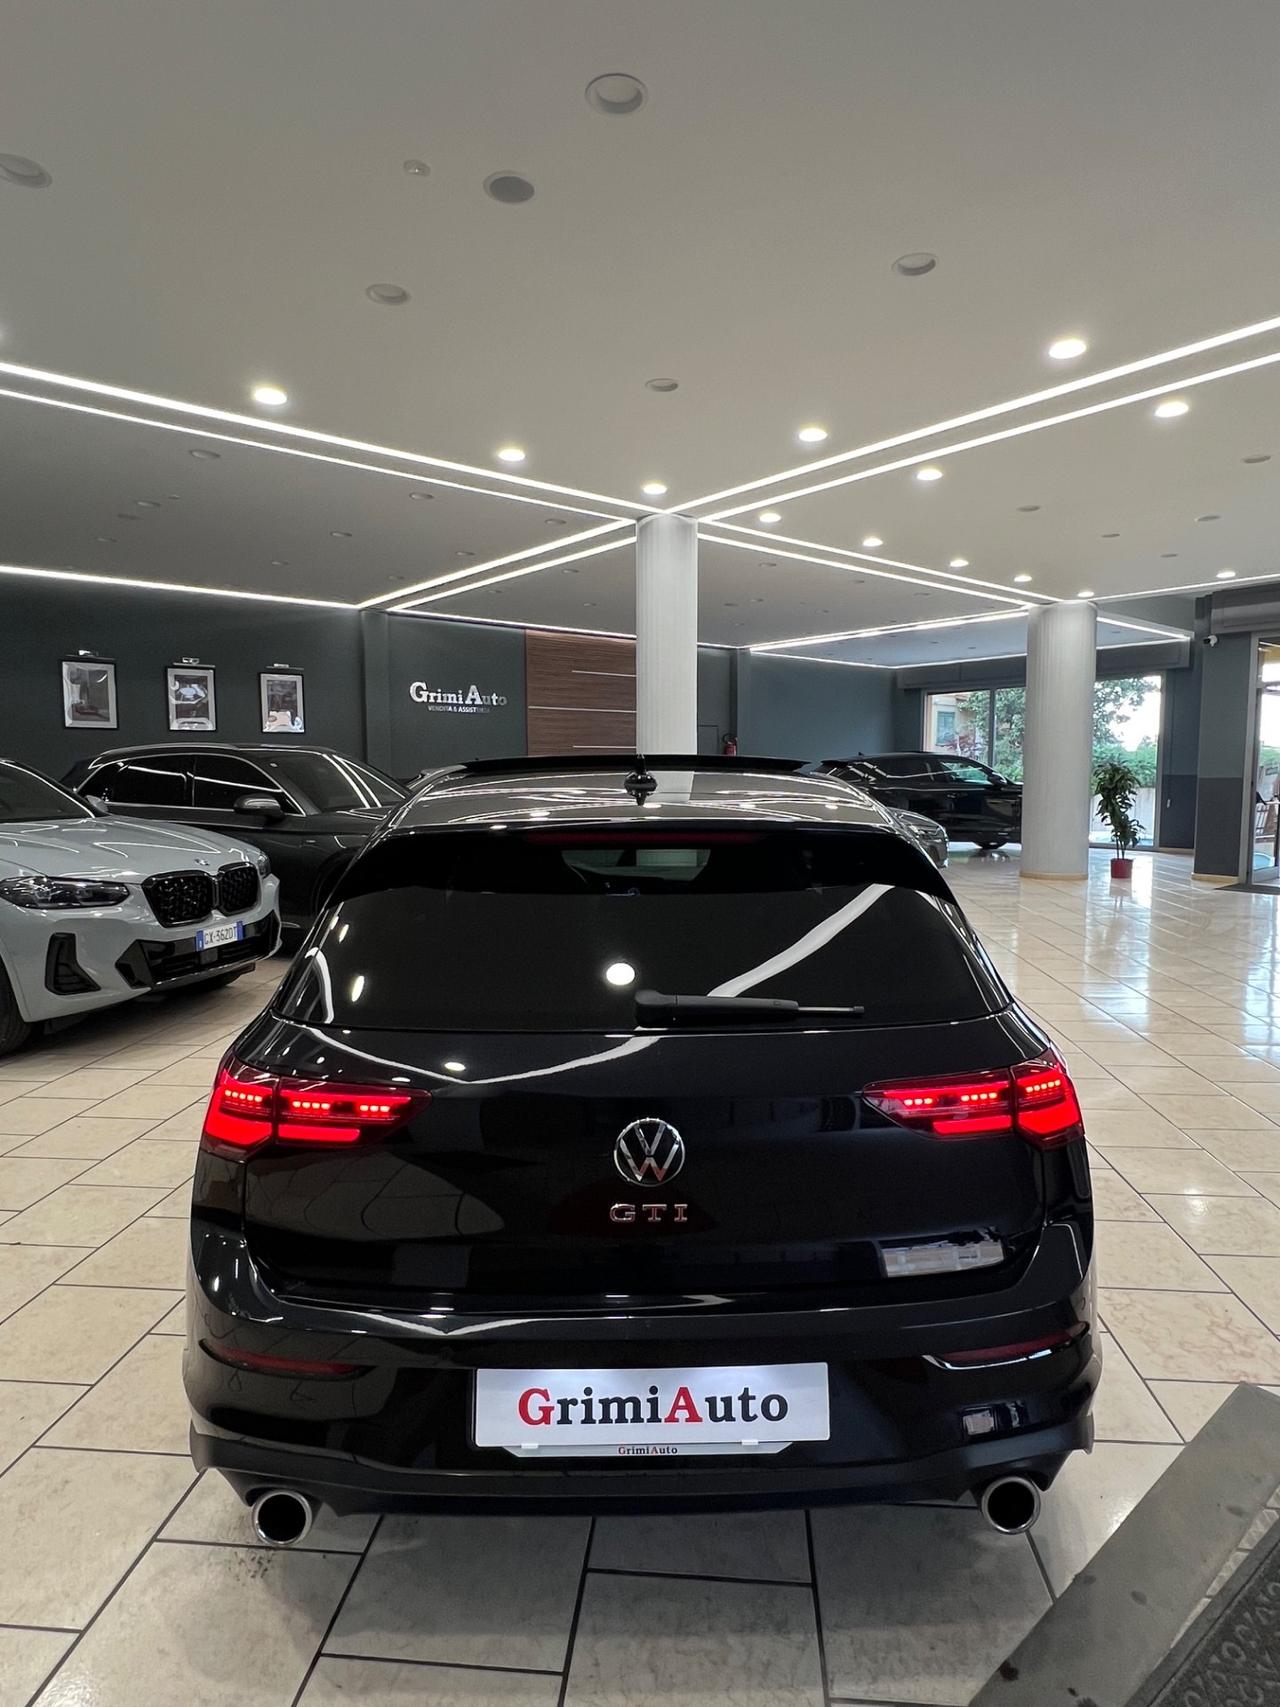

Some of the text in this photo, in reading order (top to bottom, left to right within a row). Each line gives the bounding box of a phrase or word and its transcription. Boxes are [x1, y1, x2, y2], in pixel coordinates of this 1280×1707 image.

[609, 1203, 688, 1222] GTI
[518, 1386, 789, 1425] GrimiAuto
[618, 1446, 678, 1455] GrimiAuto
